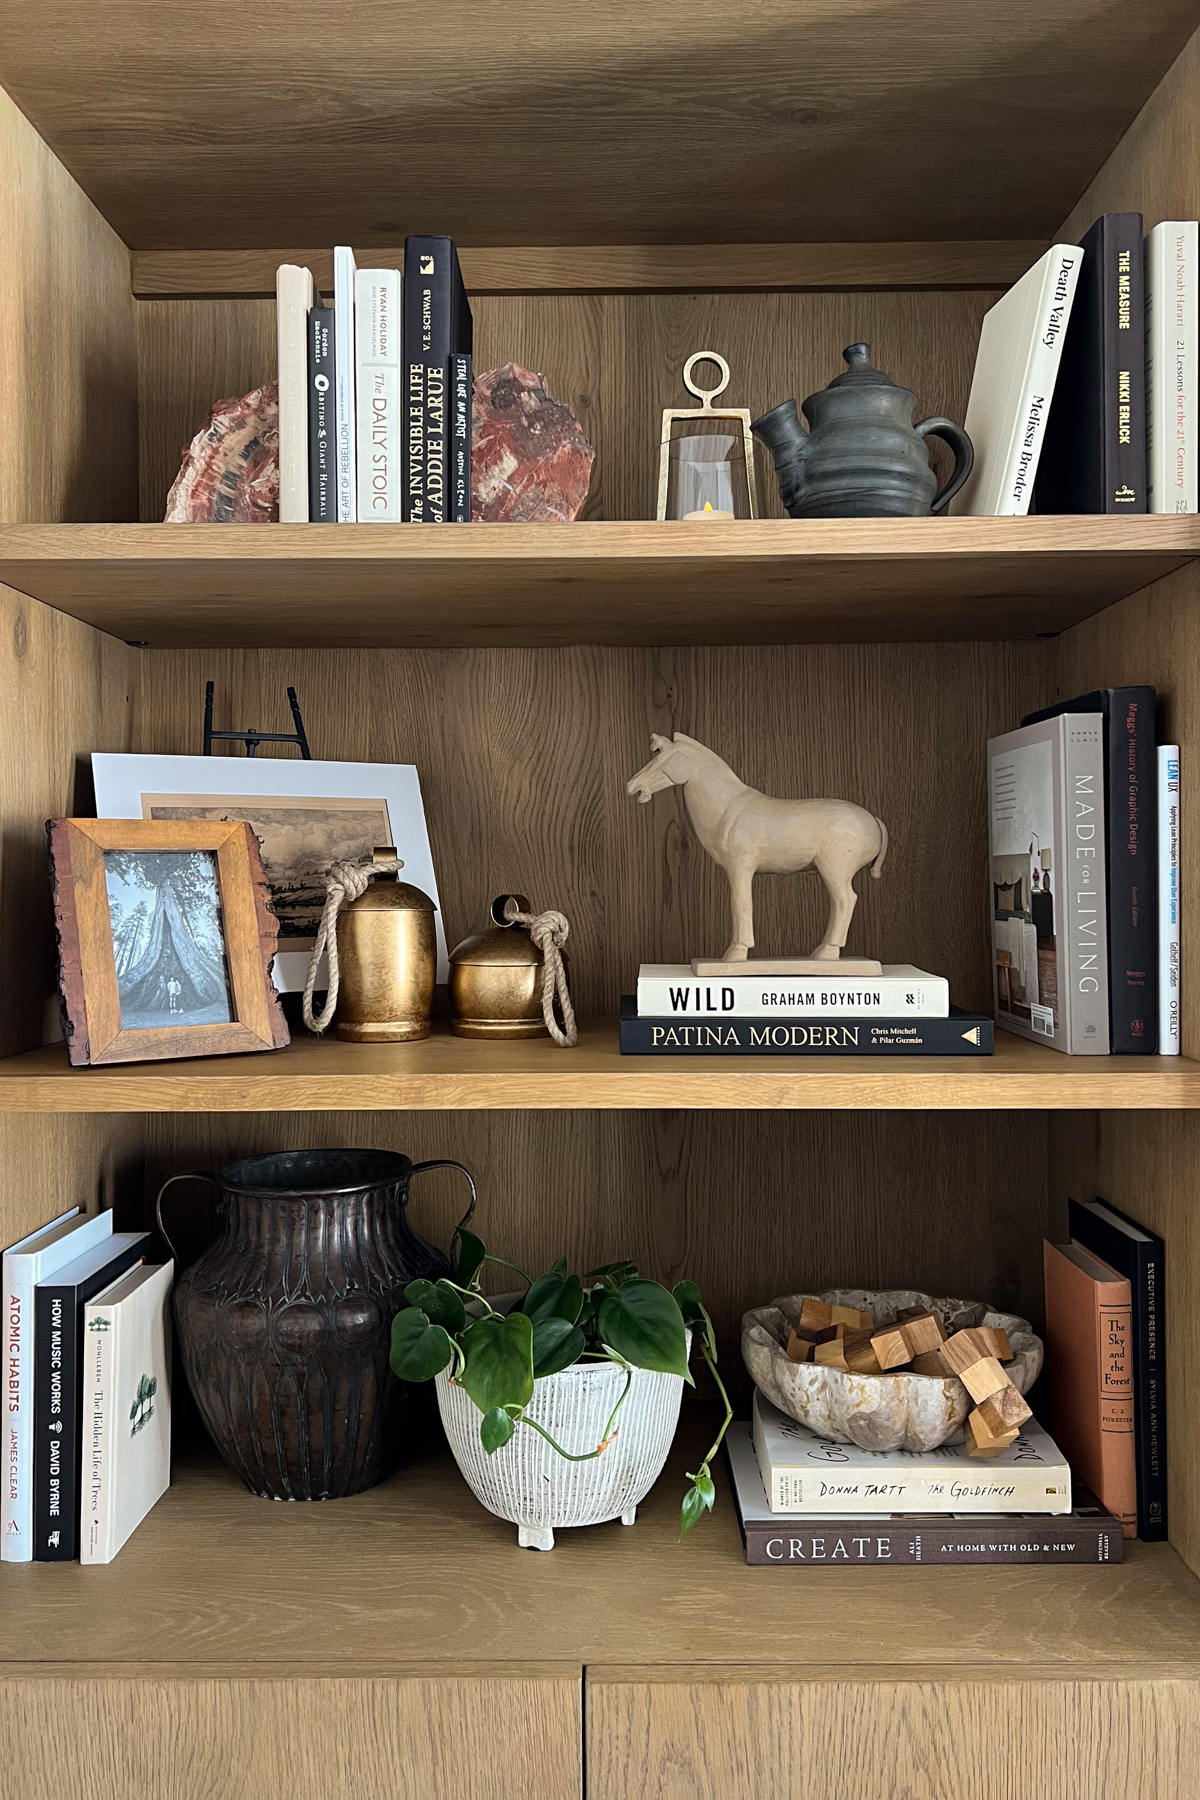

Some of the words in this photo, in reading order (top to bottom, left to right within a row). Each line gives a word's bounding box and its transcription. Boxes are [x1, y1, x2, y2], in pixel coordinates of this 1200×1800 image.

[1119, 251, 1130, 272] THE
[1176, 236, 1185, 261] Yuval
[1055, 258, 1074, 301] Death
[1177, 265, 1185, 290] Noah
[1119, 276, 1130, 329] MEASURE
[1177, 294, 1185, 326] Harari
[424, 332, 430, 340] E.
[1042, 306, 1064, 349] Valley
[423, 342, 430, 351] V.
[1177, 341, 1184, 350] 21
[410, 363, 424, 401] LIFE
[456, 359, 467, 380] STEAL
[1176, 355, 1185, 391] Lessons
[374, 374, 384, 393] The
[457, 384, 466, 398] LIKE
[1119, 372, 1130, 402] NIKKI
[315, 374, 329, 425] ORBITING
[427, 367, 443, 434] LARUE
[458, 401, 466, 412] AN
[1176, 395, 1186, 408] for
[373, 398, 387, 449] DAILY
[455, 414, 466, 438] ARTIST
[1024, 396, 1044, 446] Melissa
[1120, 406, 1130, 443] ERLICK
[410, 407, 423, 495] INVISIBLE
[428, 440, 443, 506] ADDIE
[1014, 452, 1032, 502] Broder
[1175, 448, 1185, 488] Century
[341, 476, 349, 488] OF
[373, 455, 387, 509] STOIC
[410, 499, 423, 523] The
[430, 508, 443, 522] of
[1127, 739, 1137, 771] History
[1129, 774, 1138, 783] of
[1168, 760, 1178, 779] LEAN
[1168, 782, 1178, 792] UX
[1075, 775, 1095, 859] MADE
[1128, 786, 1138, 821] Graphic
[1128, 824, 1138, 855] Design
[1077, 892, 1098, 993] LIVING
[669, 988, 734, 1011] WILD
[762, 993, 814, 1005] GRAHAM
[821, 993, 880, 1005] BOYNTON
[651, 1027, 741, 1046] PATINA
[749, 1027, 859, 1046] MODERN
[10, 1295, 20, 1352] ATOMIC
[52, 1299, 61, 1327] HOW
[1108, 1320, 1125, 1332] The
[52, 1331, 61, 1368] MUSIC
[1109, 1334, 1125, 1347] Sky
[1109, 1347, 1125, 1358] and
[1105, 1374, 1130, 1385] Forest
[1111, 1361, 1124, 1371] the
[9, 1358, 19, 1412] HABITS
[51, 1371, 61, 1414] WORKS
[94, 1390, 103, 1409] The
[93, 1412, 103, 1448] Hidden
[10, 1429, 18, 1462] JAMES
[50, 1441, 60, 1475] DAVID
[93, 1450, 102, 1469] Life
[10, 1466, 18, 1499] CLEAR
[93, 1472, 102, 1481] of
[819, 1481, 858, 1497] DONNA
[864, 1485, 906, 1497] TARTT
[928, 1484, 944, 1495] The
[50, 1479, 59, 1516] BYRNE
[92, 1483, 101, 1510] Trees
[766, 1538, 892, 1559] CREATE
